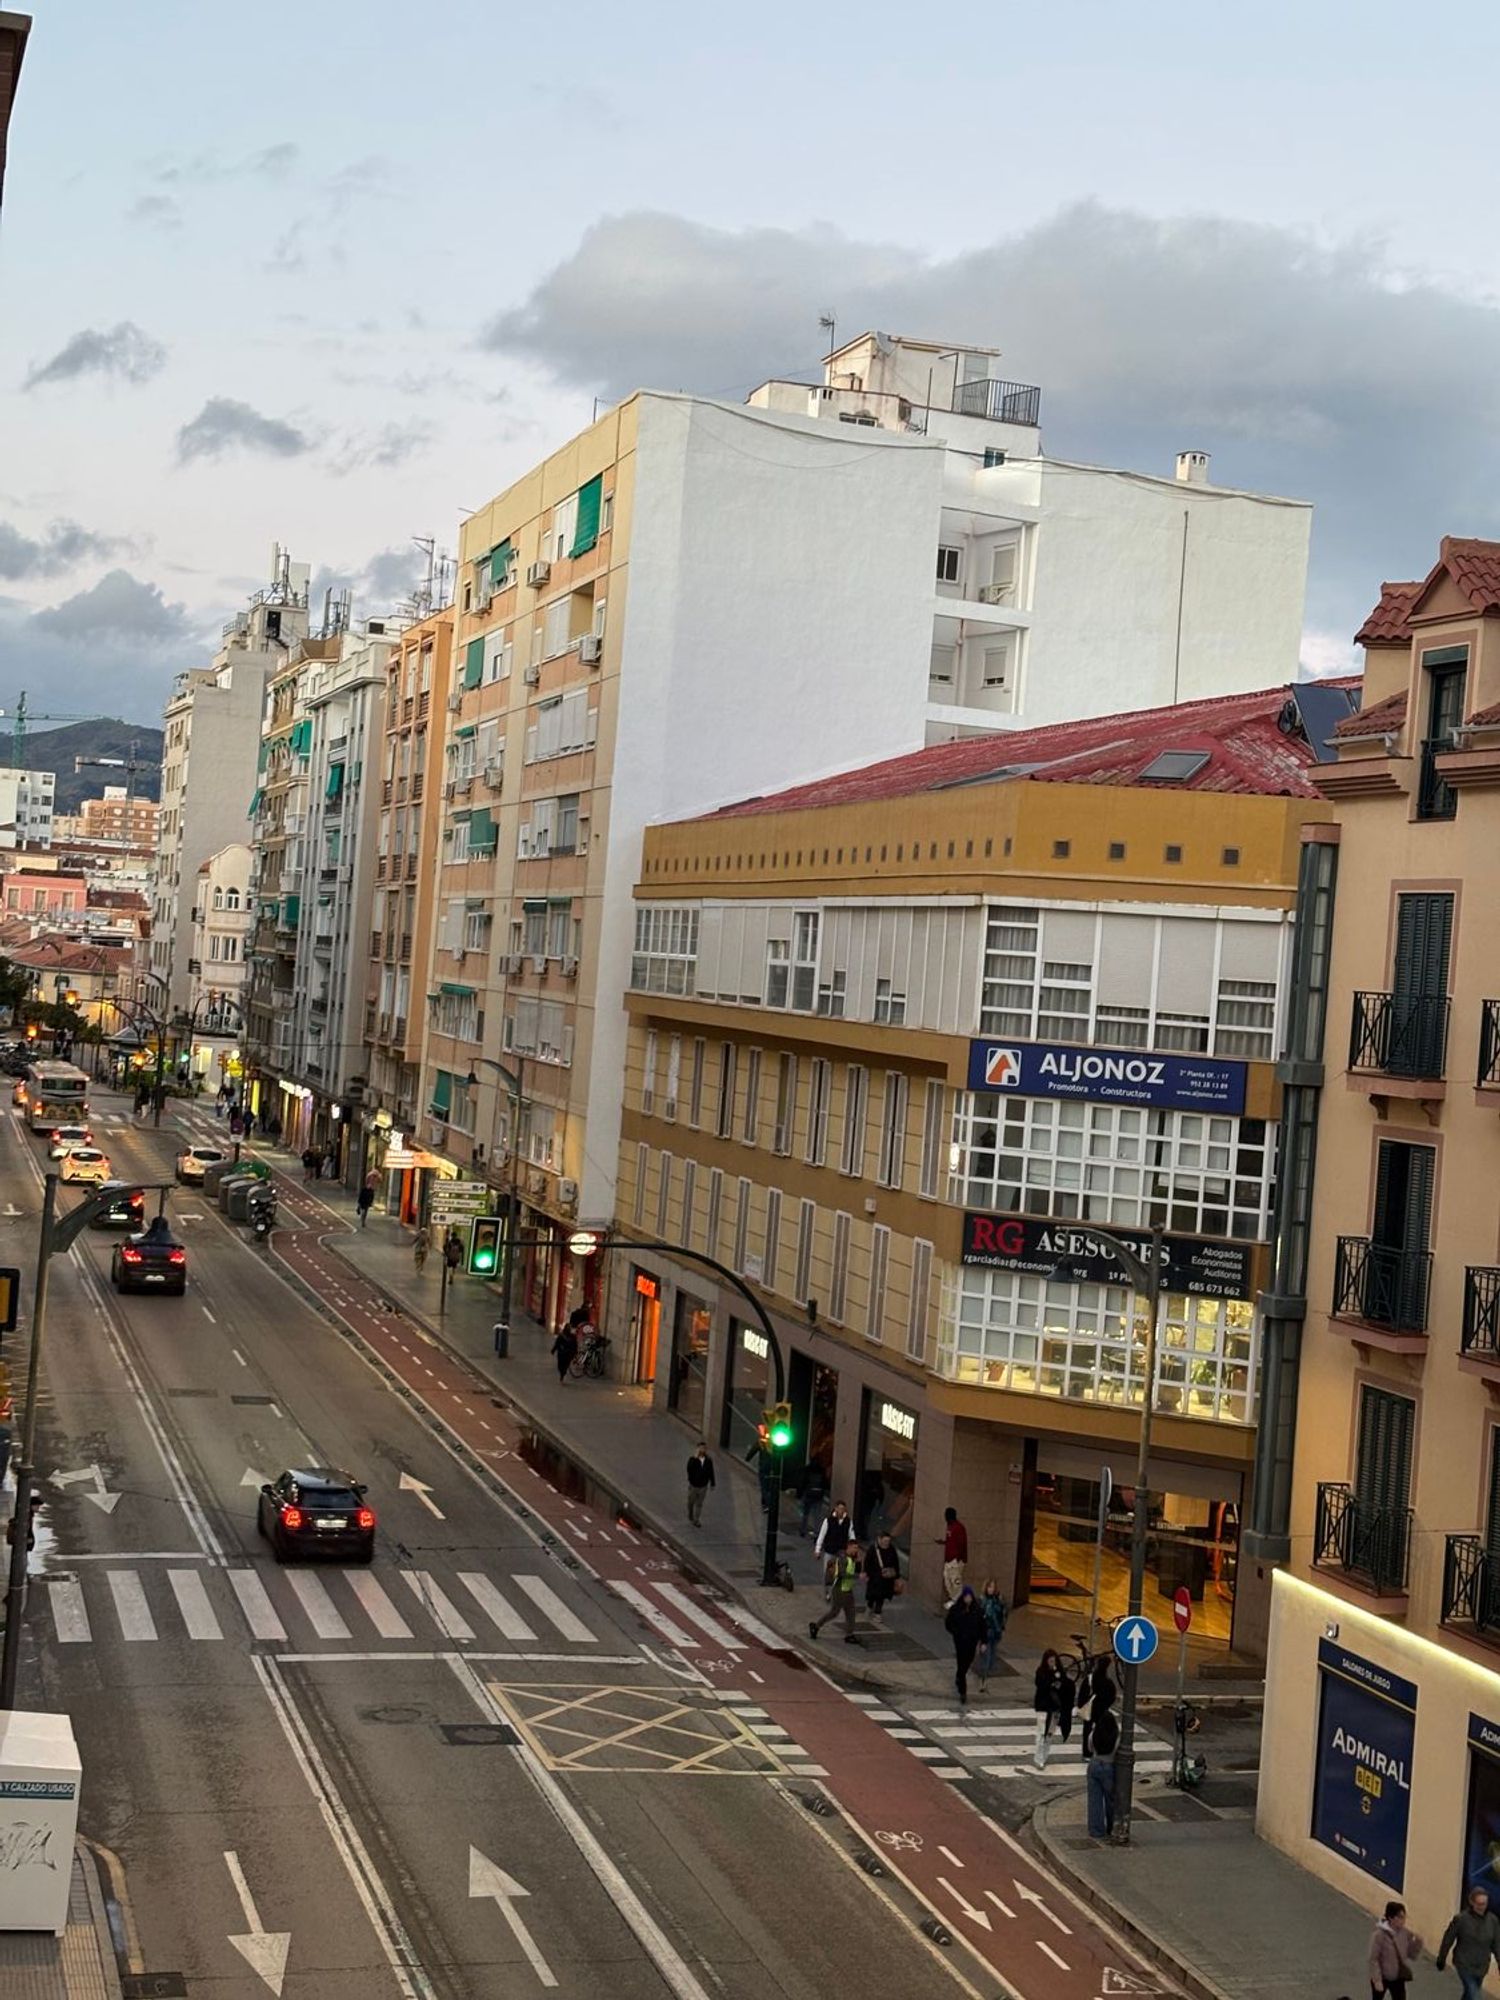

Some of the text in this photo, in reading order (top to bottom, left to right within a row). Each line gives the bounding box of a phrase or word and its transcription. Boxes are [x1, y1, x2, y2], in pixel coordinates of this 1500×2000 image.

[1039, 1053, 1165, 1085] ALJONOZ
[1048, 1081, 1152, 1099] Promotora Constructora
[972, 1216, 1026, 1255] RG
[1202, 1247, 1243, 1260] Abogados
[1191, 1256, 1242, 1270] Economistas
[1203, 1268, 1242, 1280] Auditores
[1206, 1283, 1223, 1294] 673
[1224, 1286, 1241, 1296] 662
[1342, 1658, 1390, 1690] SALONES DE JUEGO
[1332, 1727, 1409, 1790] ADMIRAL
[11, 1782, 47, 1793] CALZADO
[48, 1784, 75, 1793] USADO
[1356, 1770, 1380, 1795] BET
